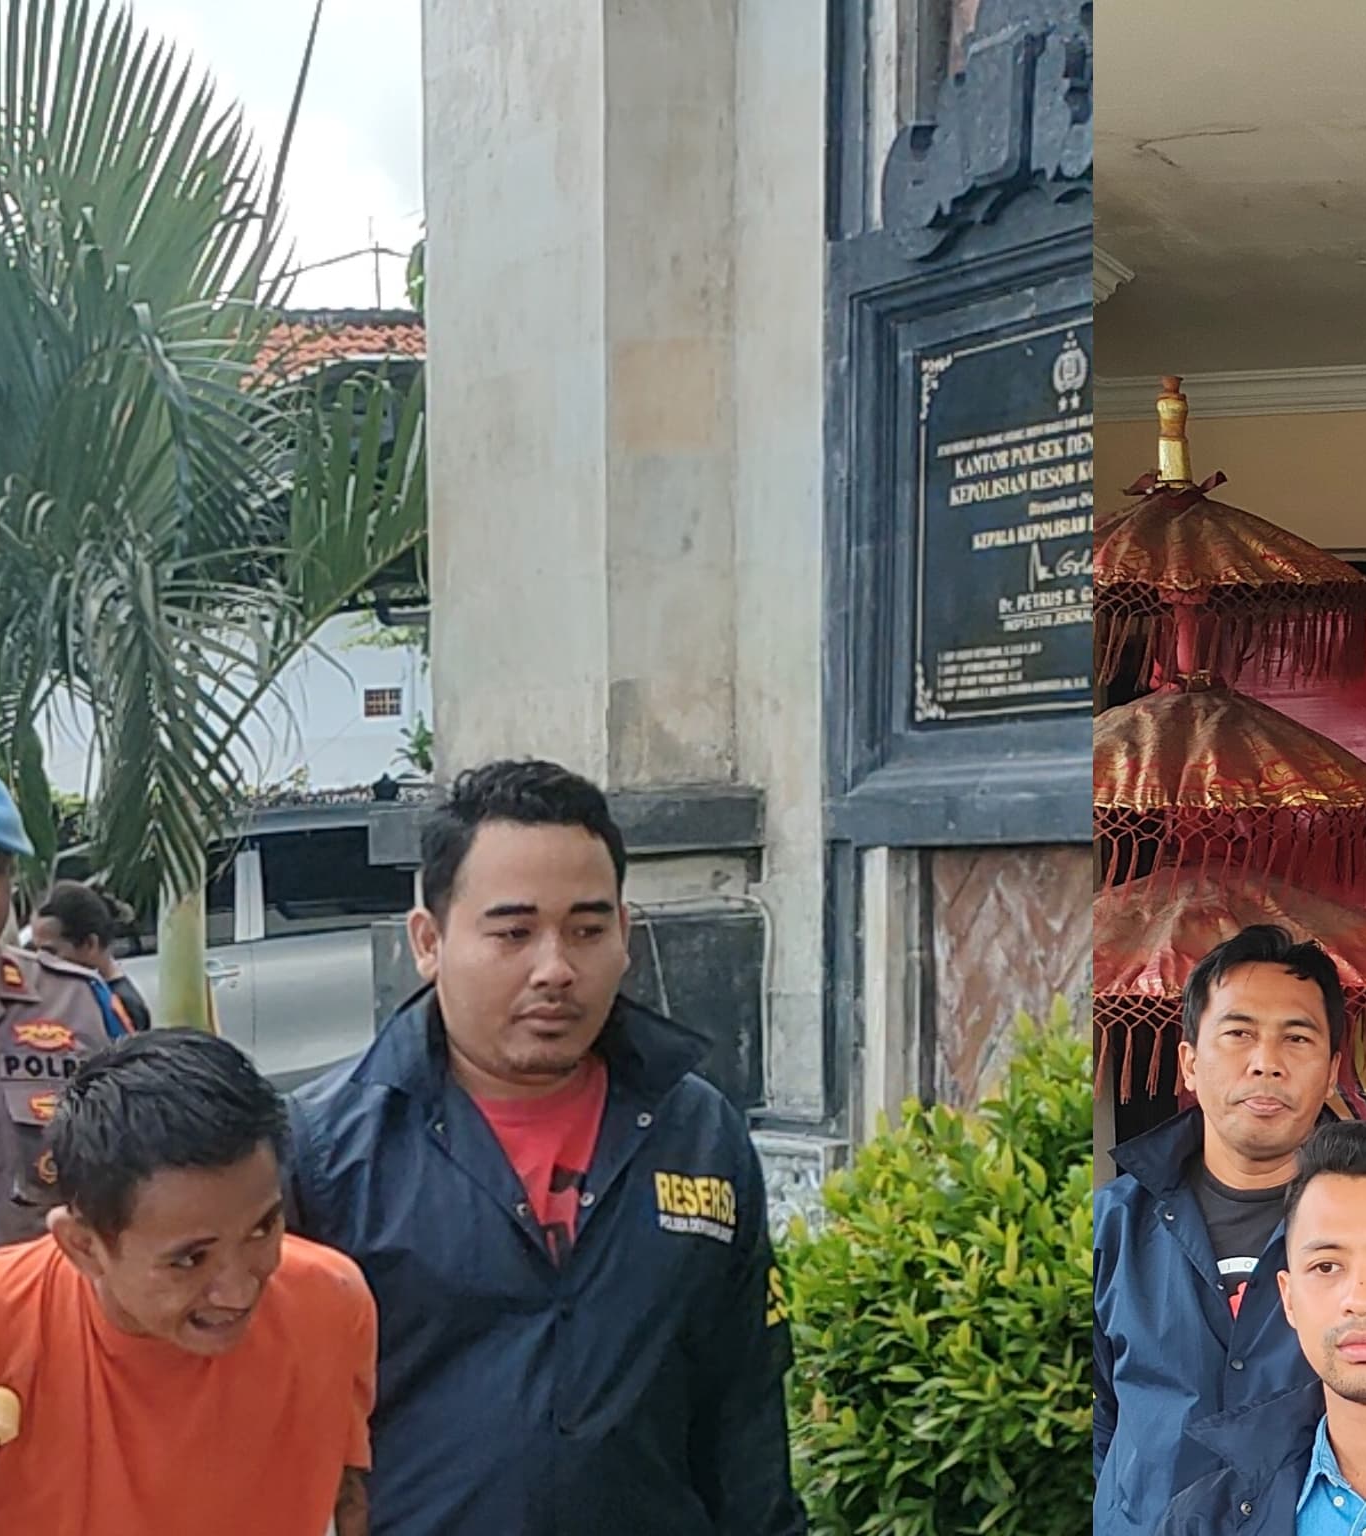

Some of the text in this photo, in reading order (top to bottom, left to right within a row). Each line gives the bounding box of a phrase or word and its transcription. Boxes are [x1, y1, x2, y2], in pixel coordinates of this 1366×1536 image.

[955, 450, 1009, 479] KANTOR
[1010, 439, 1064, 467] POLSEK
[949, 472, 1028, 507] KEPOLISIAN
[1030, 463, 1075, 493] RESOR
[1017, 589, 1064, 611] PETRUS
